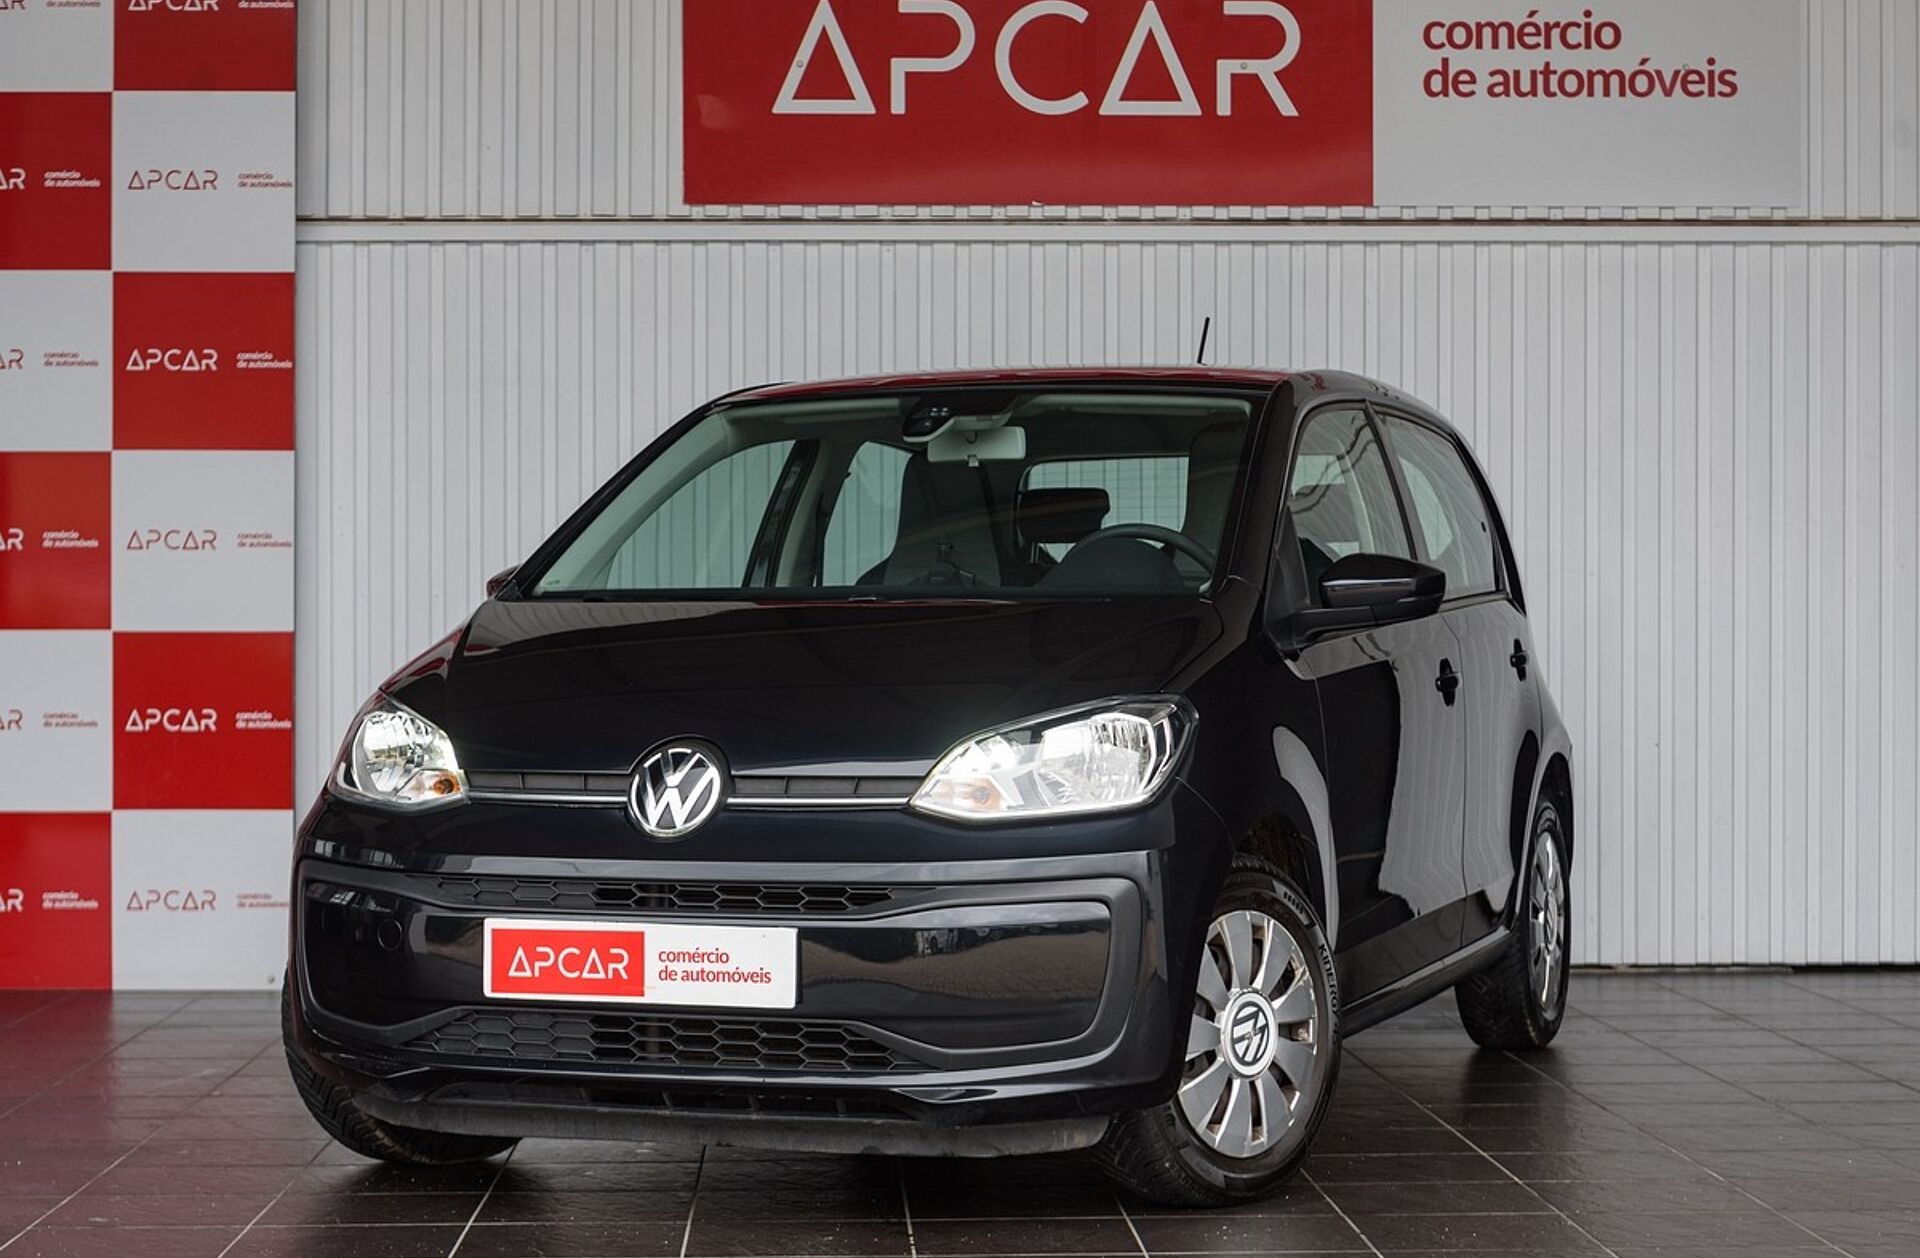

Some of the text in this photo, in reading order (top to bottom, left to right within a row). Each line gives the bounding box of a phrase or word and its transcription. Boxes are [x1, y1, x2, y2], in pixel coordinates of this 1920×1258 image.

[1423, 9, 1622, 51] comércio
[771, 0, 1301, 116] APCAR
[1423, 57, 1738, 98] de automóveis
[128, 170, 218, 190] APCAR
[126, 348, 218, 371] APCAR
[126, 529, 216, 550] APCAR
[124, 708, 216, 732] APCAR
[126, 890, 216, 911] APCAR
[508, 946, 629, 980] APCAR
[658, 947, 730, 964] comércio
[658, 965, 772, 984] de automóveis
